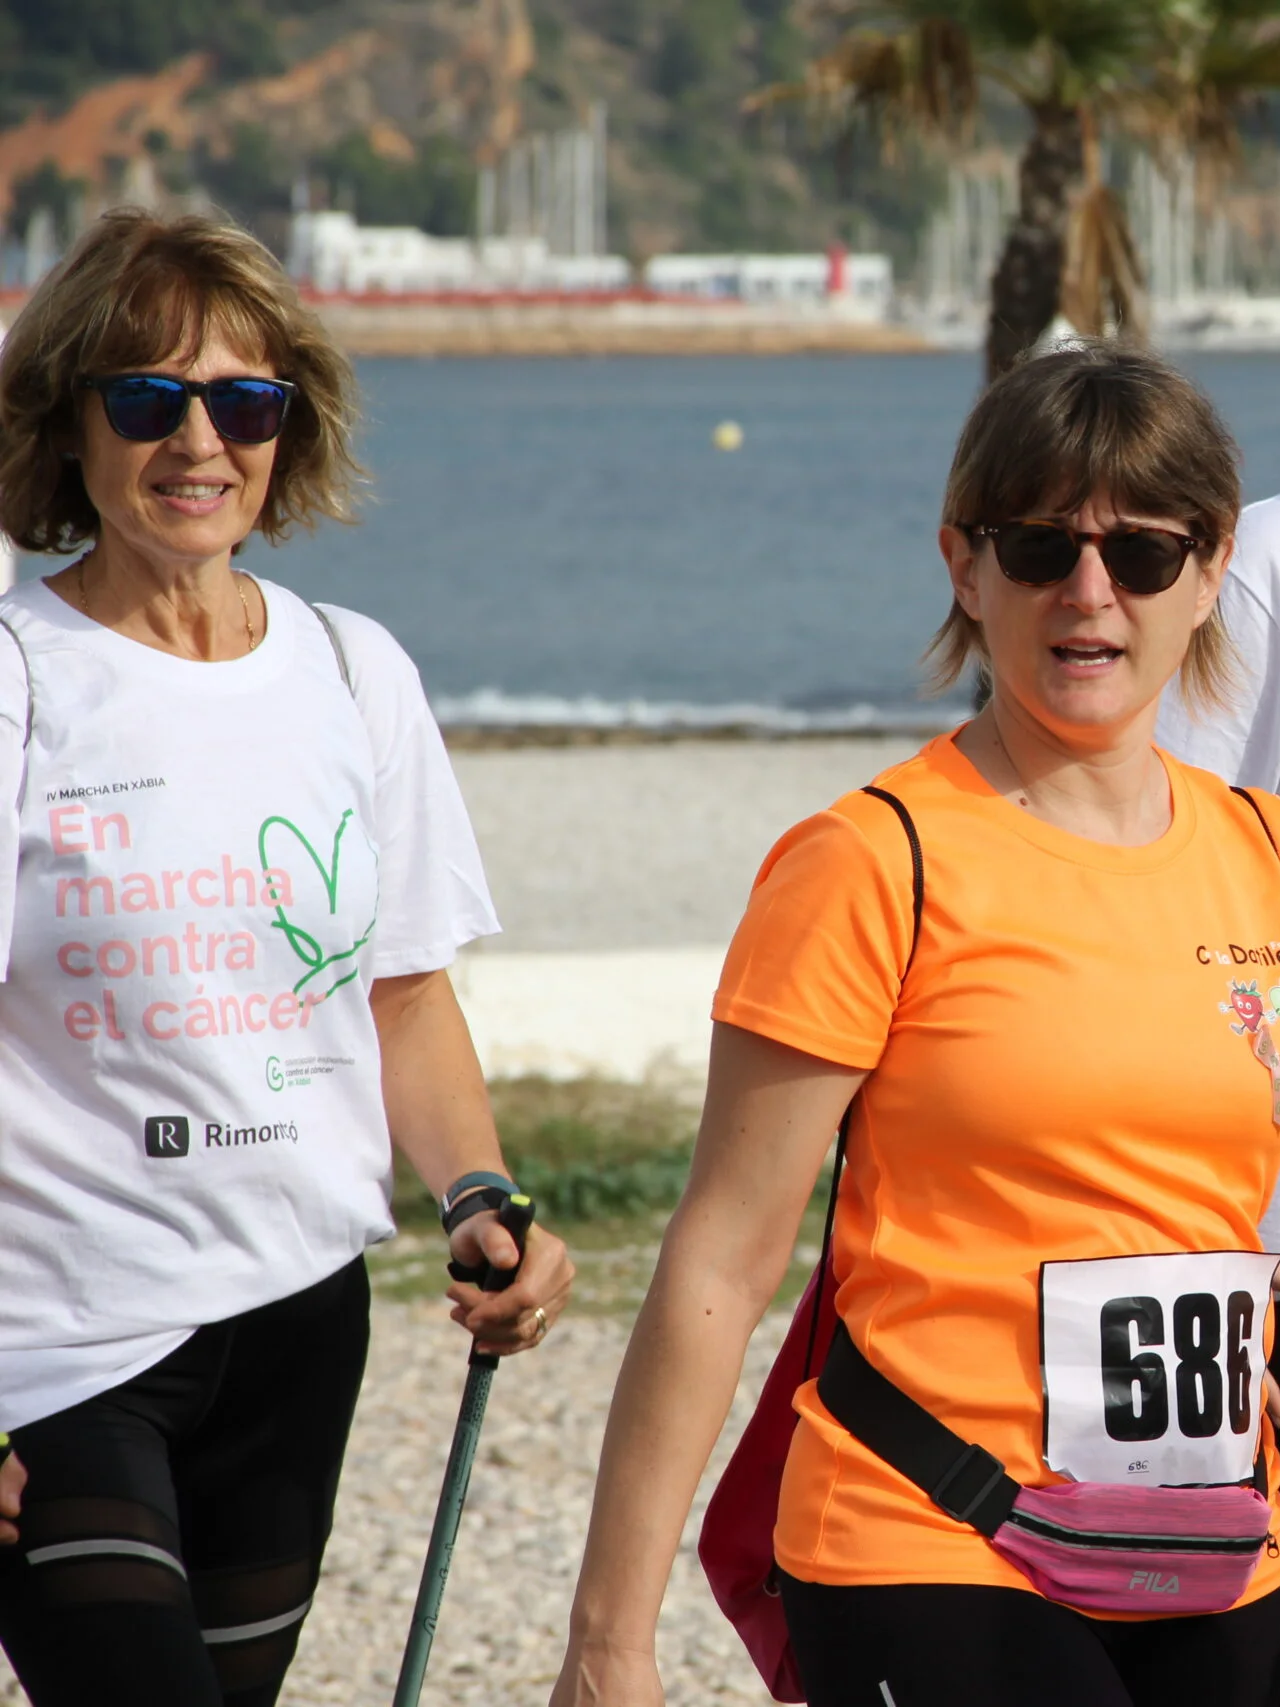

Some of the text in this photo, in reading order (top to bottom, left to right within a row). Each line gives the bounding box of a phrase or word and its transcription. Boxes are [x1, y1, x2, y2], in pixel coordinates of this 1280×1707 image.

[46, 777, 166, 802] IV MARCHA EN XÀBIA
[48, 804, 132, 857] En
[55, 854, 295, 918] marcha
[56, 921, 256, 979] contra
[63, 983, 328, 1042] el cáncer
[1100, 1290, 1255, 1443] 686
[1129, 1570, 1180, 1594] FILA
